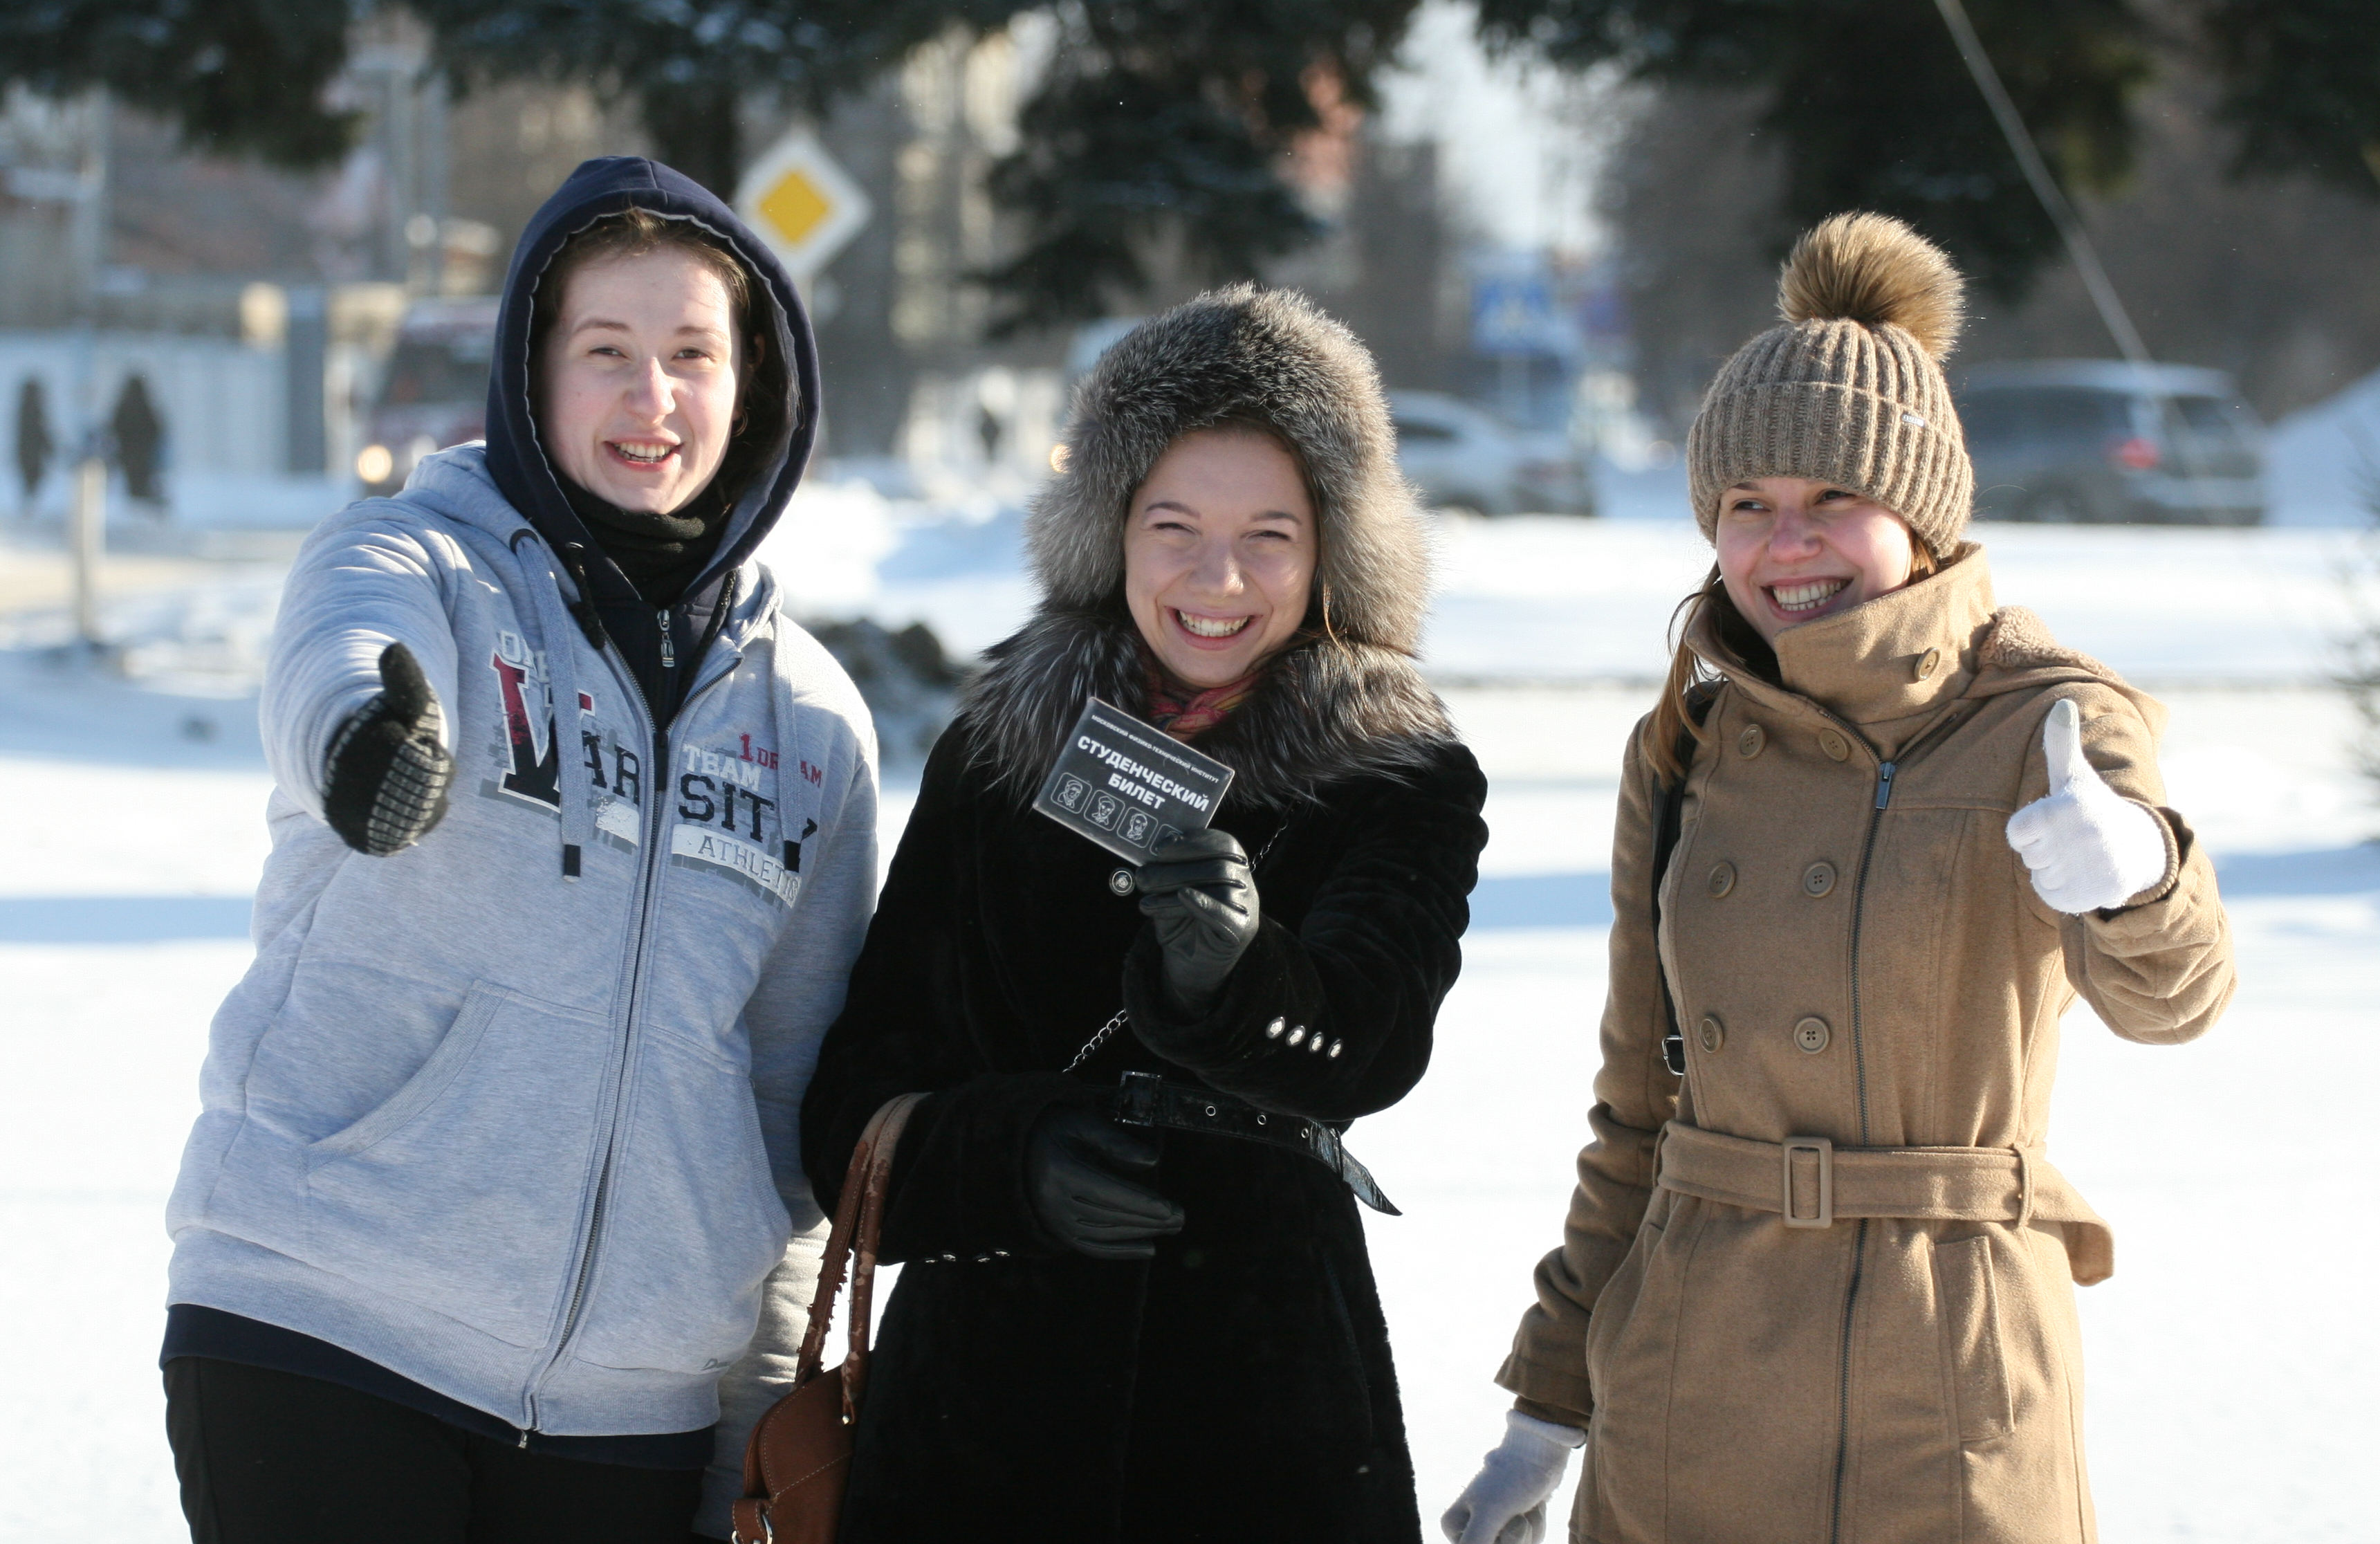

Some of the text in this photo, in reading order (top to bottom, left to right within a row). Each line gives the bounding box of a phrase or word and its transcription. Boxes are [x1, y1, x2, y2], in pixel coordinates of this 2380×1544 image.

[683, 744, 762, 791] TEAM
[739, 732, 822, 788] 1 DRAM
[1078, 736, 1210, 812] СТУДЕНЧЕСКИЙ
[1091, 715, 1129, 737] МОСКОВСКИЙ
[1191, 766, 1219, 783] ИНСТИТУТ
[1108, 773, 1165, 809] БИЛЕТ
